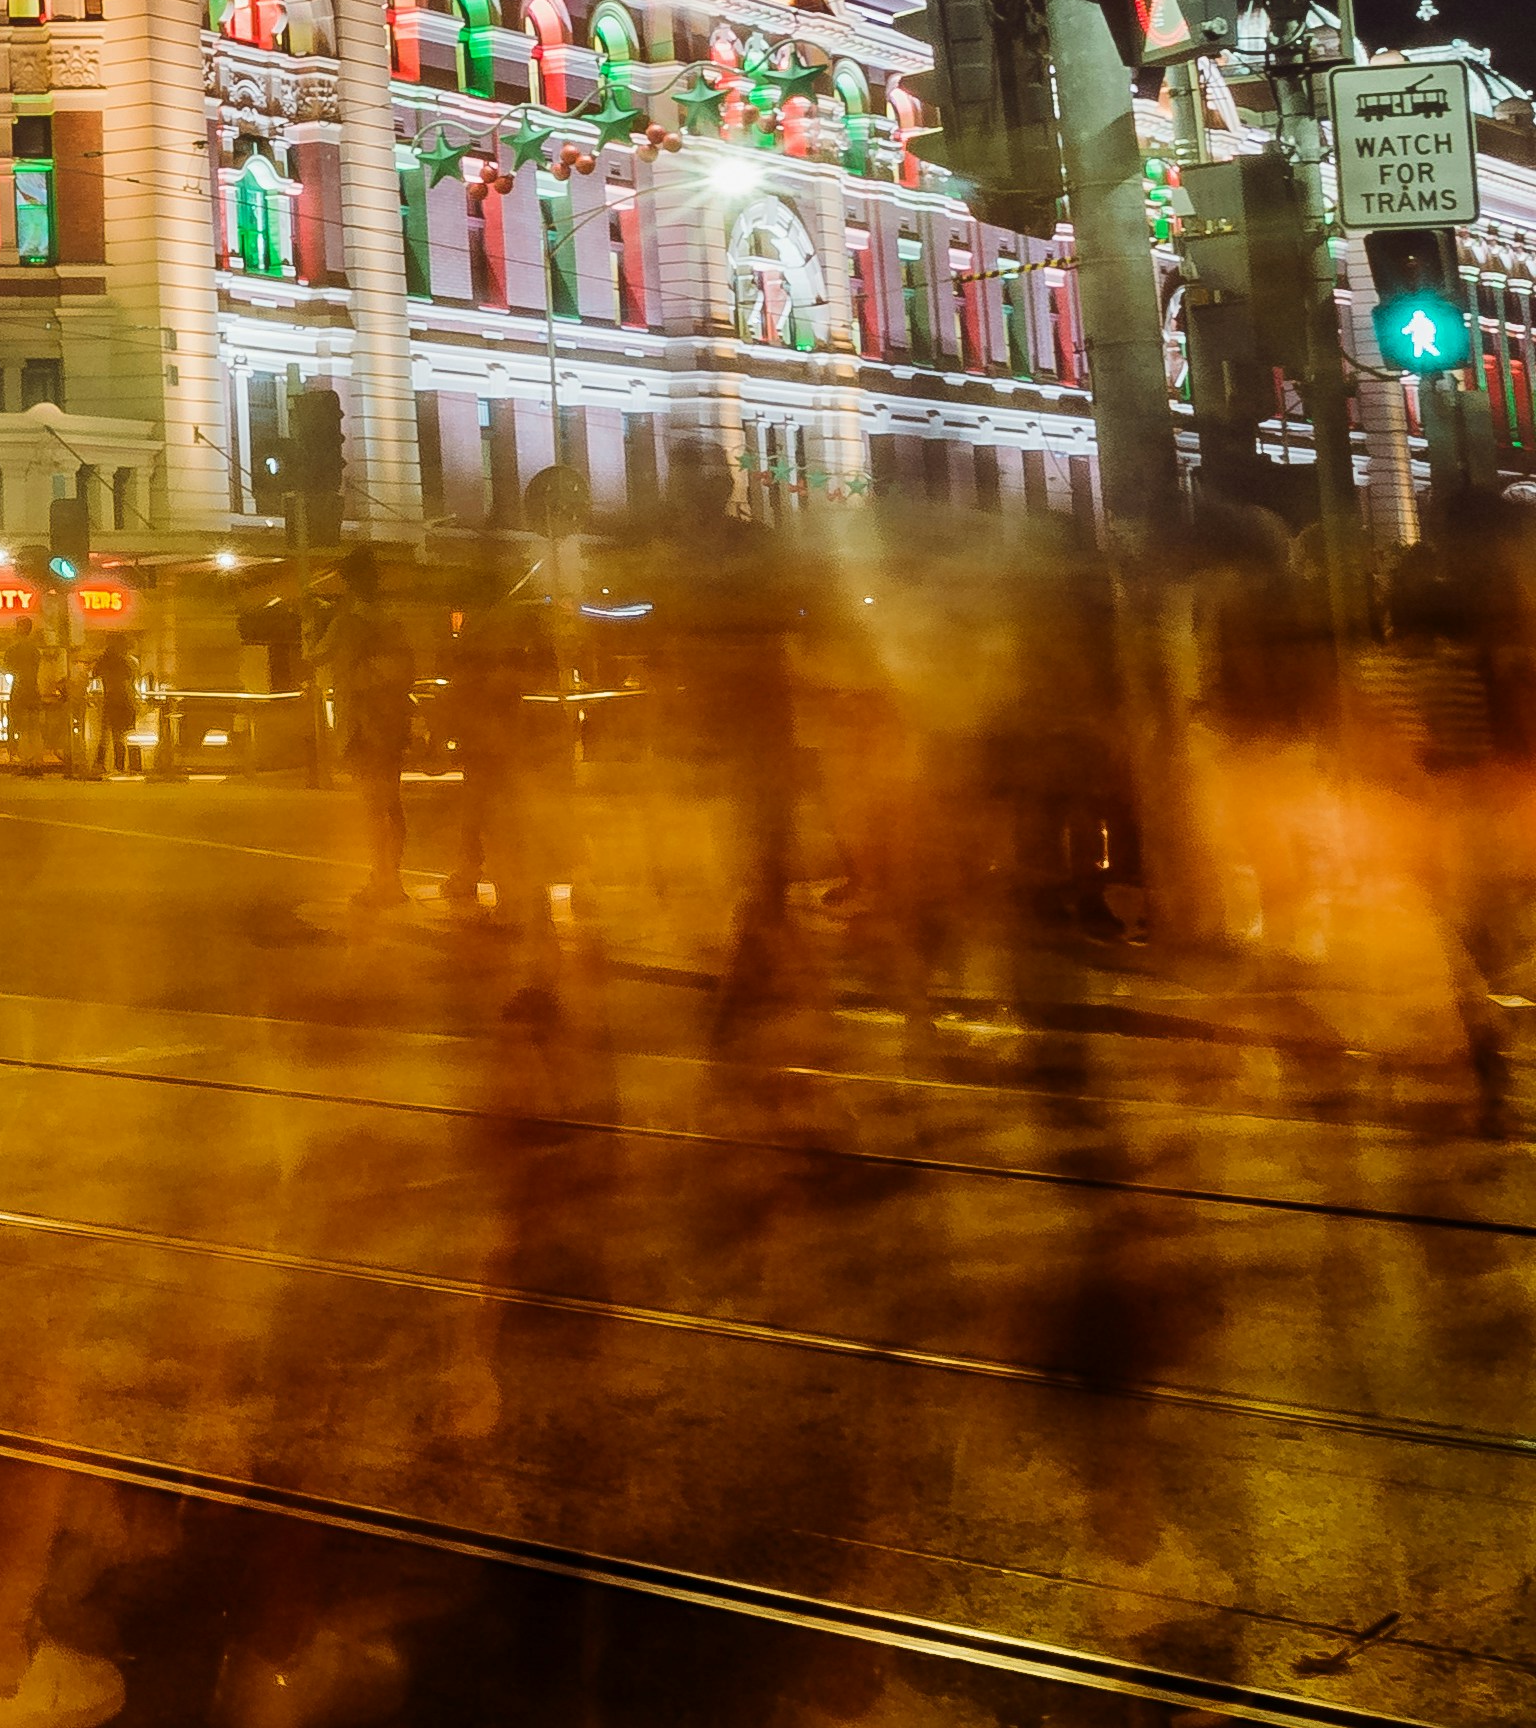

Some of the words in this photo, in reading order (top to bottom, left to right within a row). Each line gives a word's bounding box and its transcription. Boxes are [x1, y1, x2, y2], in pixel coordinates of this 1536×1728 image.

[1355, 133, 1453, 158] WATCH
[1379, 163, 1435, 185] FOR
[1361, 189, 1457, 214] TRAMS
[79, 591, 123, 611] TERS
